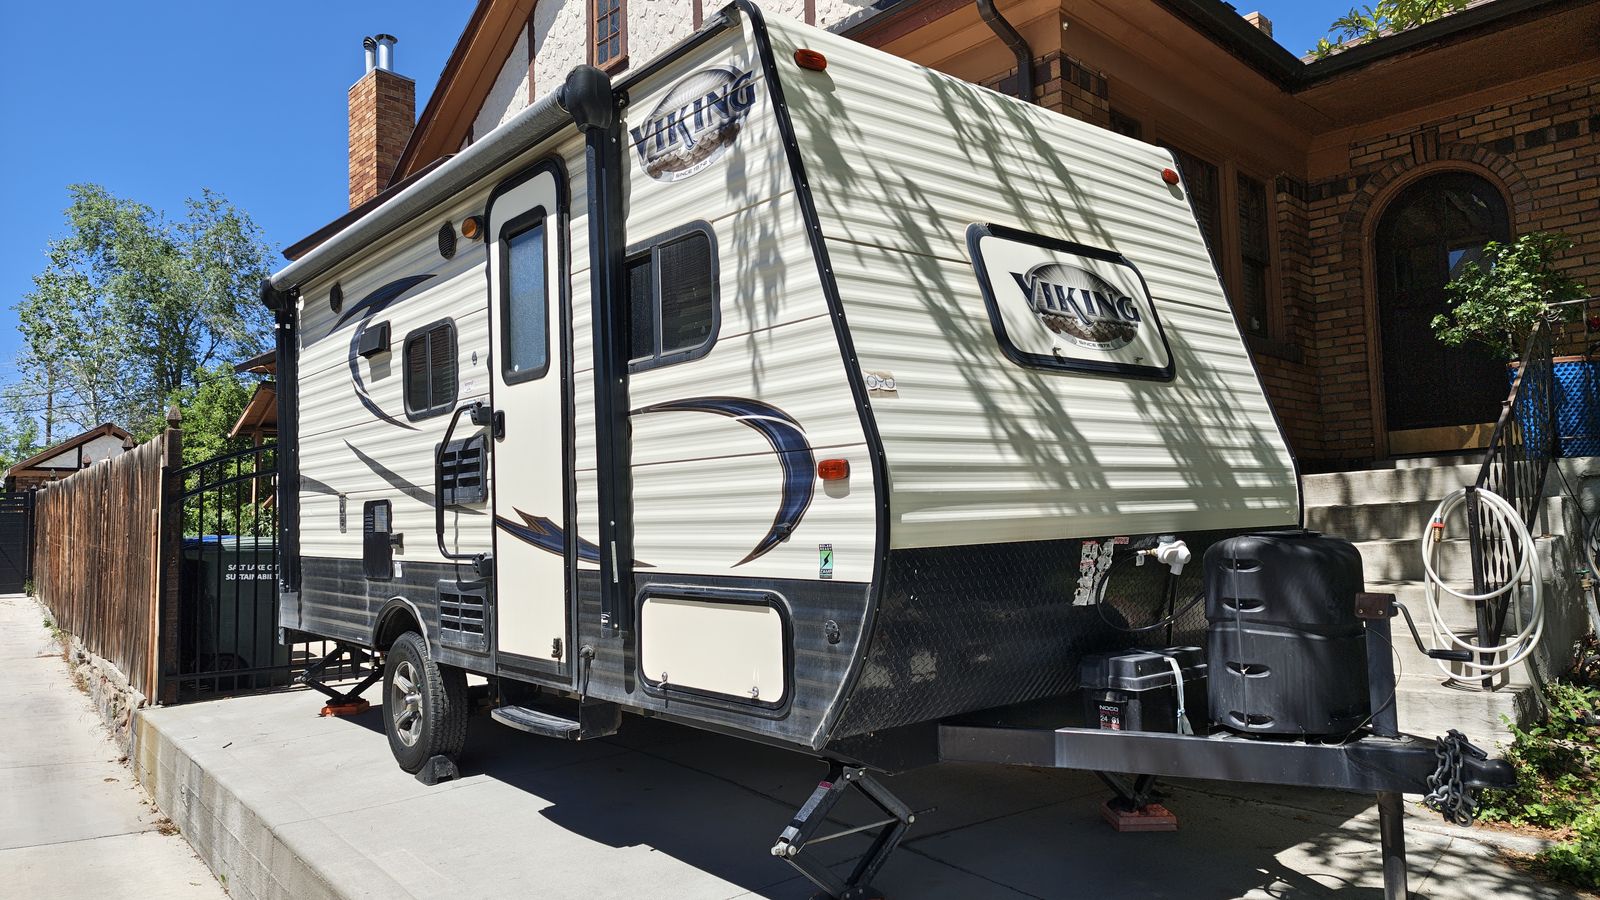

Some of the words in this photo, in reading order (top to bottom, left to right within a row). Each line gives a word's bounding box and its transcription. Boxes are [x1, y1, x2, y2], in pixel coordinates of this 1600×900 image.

[629, 70, 756, 164] VIKING
[675, 168, 693, 178] SINCE
[1009, 271, 1141, 327] VIKING
[1099, 704, 1119, 712] NOCO
